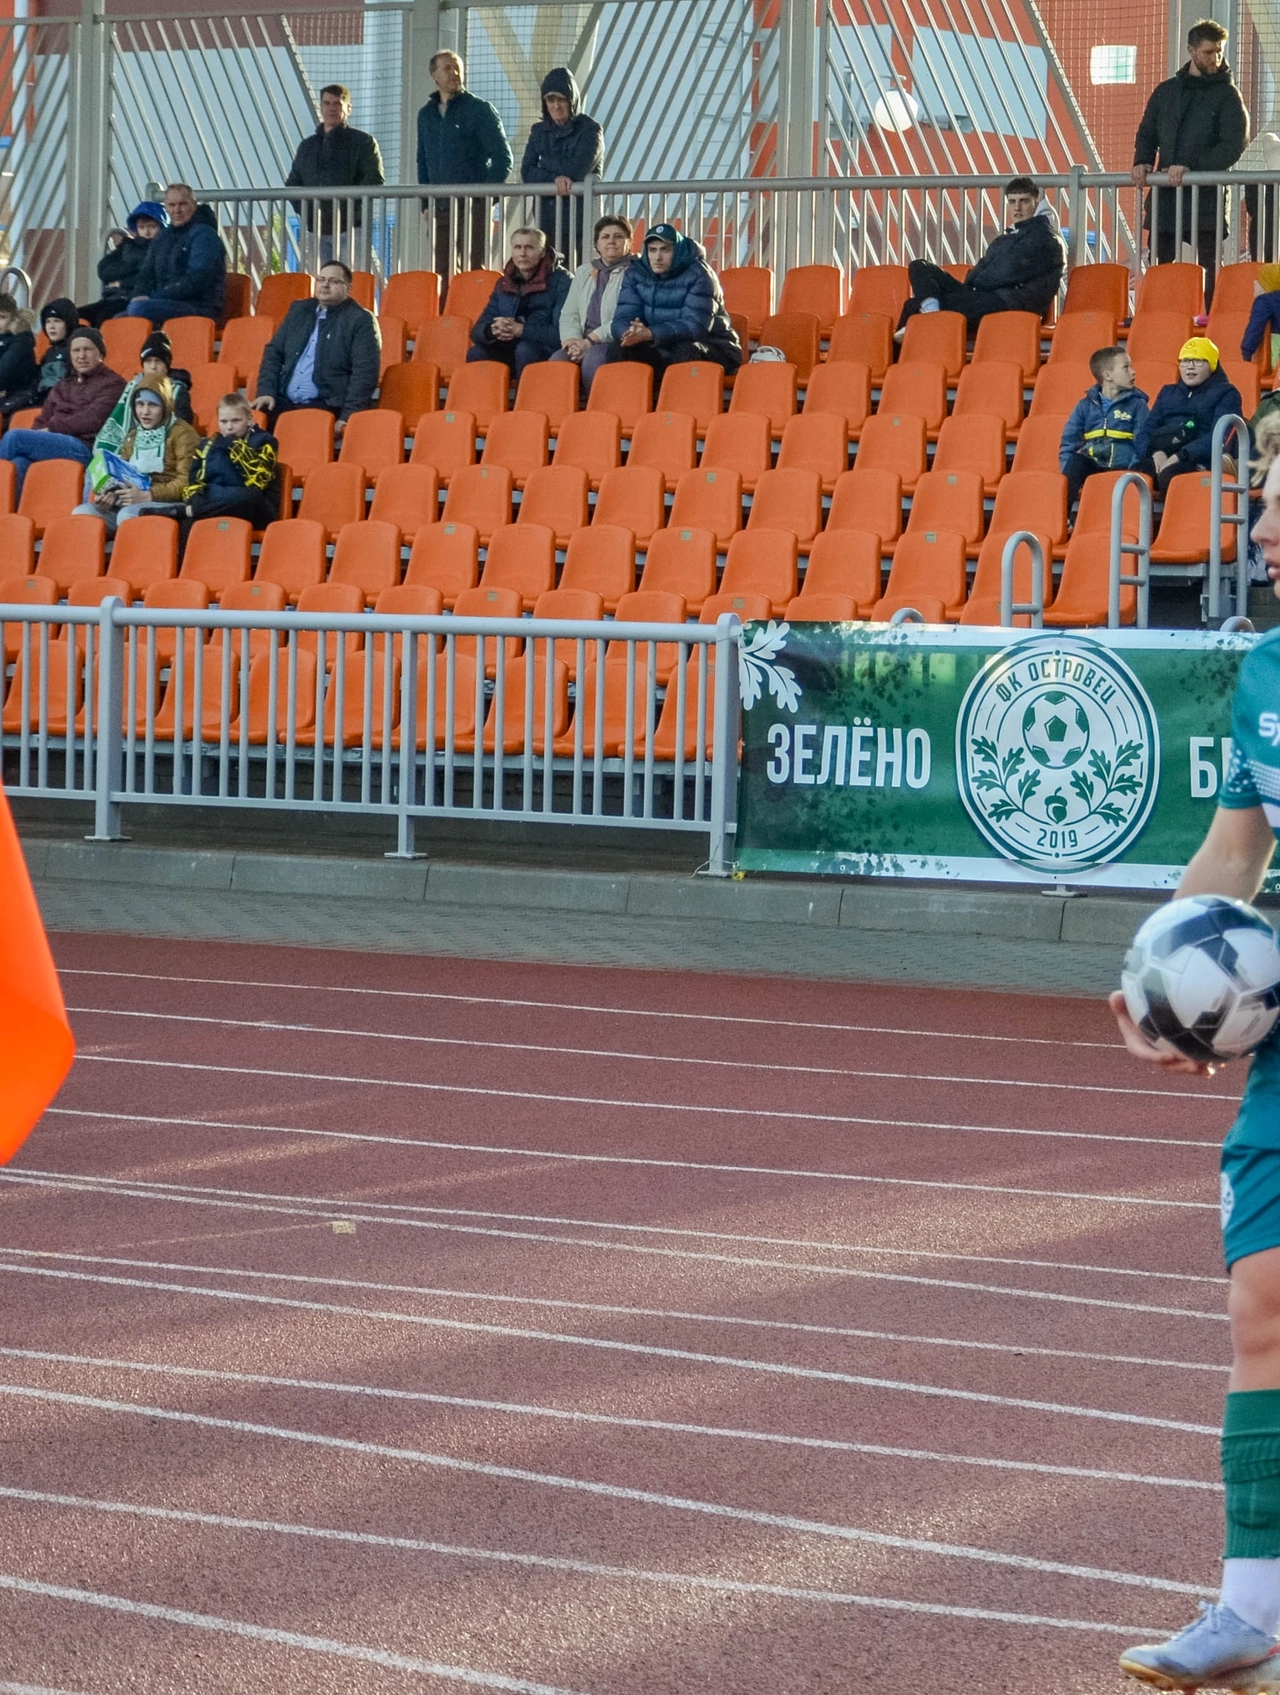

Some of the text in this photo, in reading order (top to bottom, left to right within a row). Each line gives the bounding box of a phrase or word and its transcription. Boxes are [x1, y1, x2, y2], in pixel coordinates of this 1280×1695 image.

[996, 659, 1116, 705] ФК ОСТРОВЕЦ
[766, 716, 1233, 798] ЗЕЛЁНО Б
[1036, 827, 1078, 849] 2019
